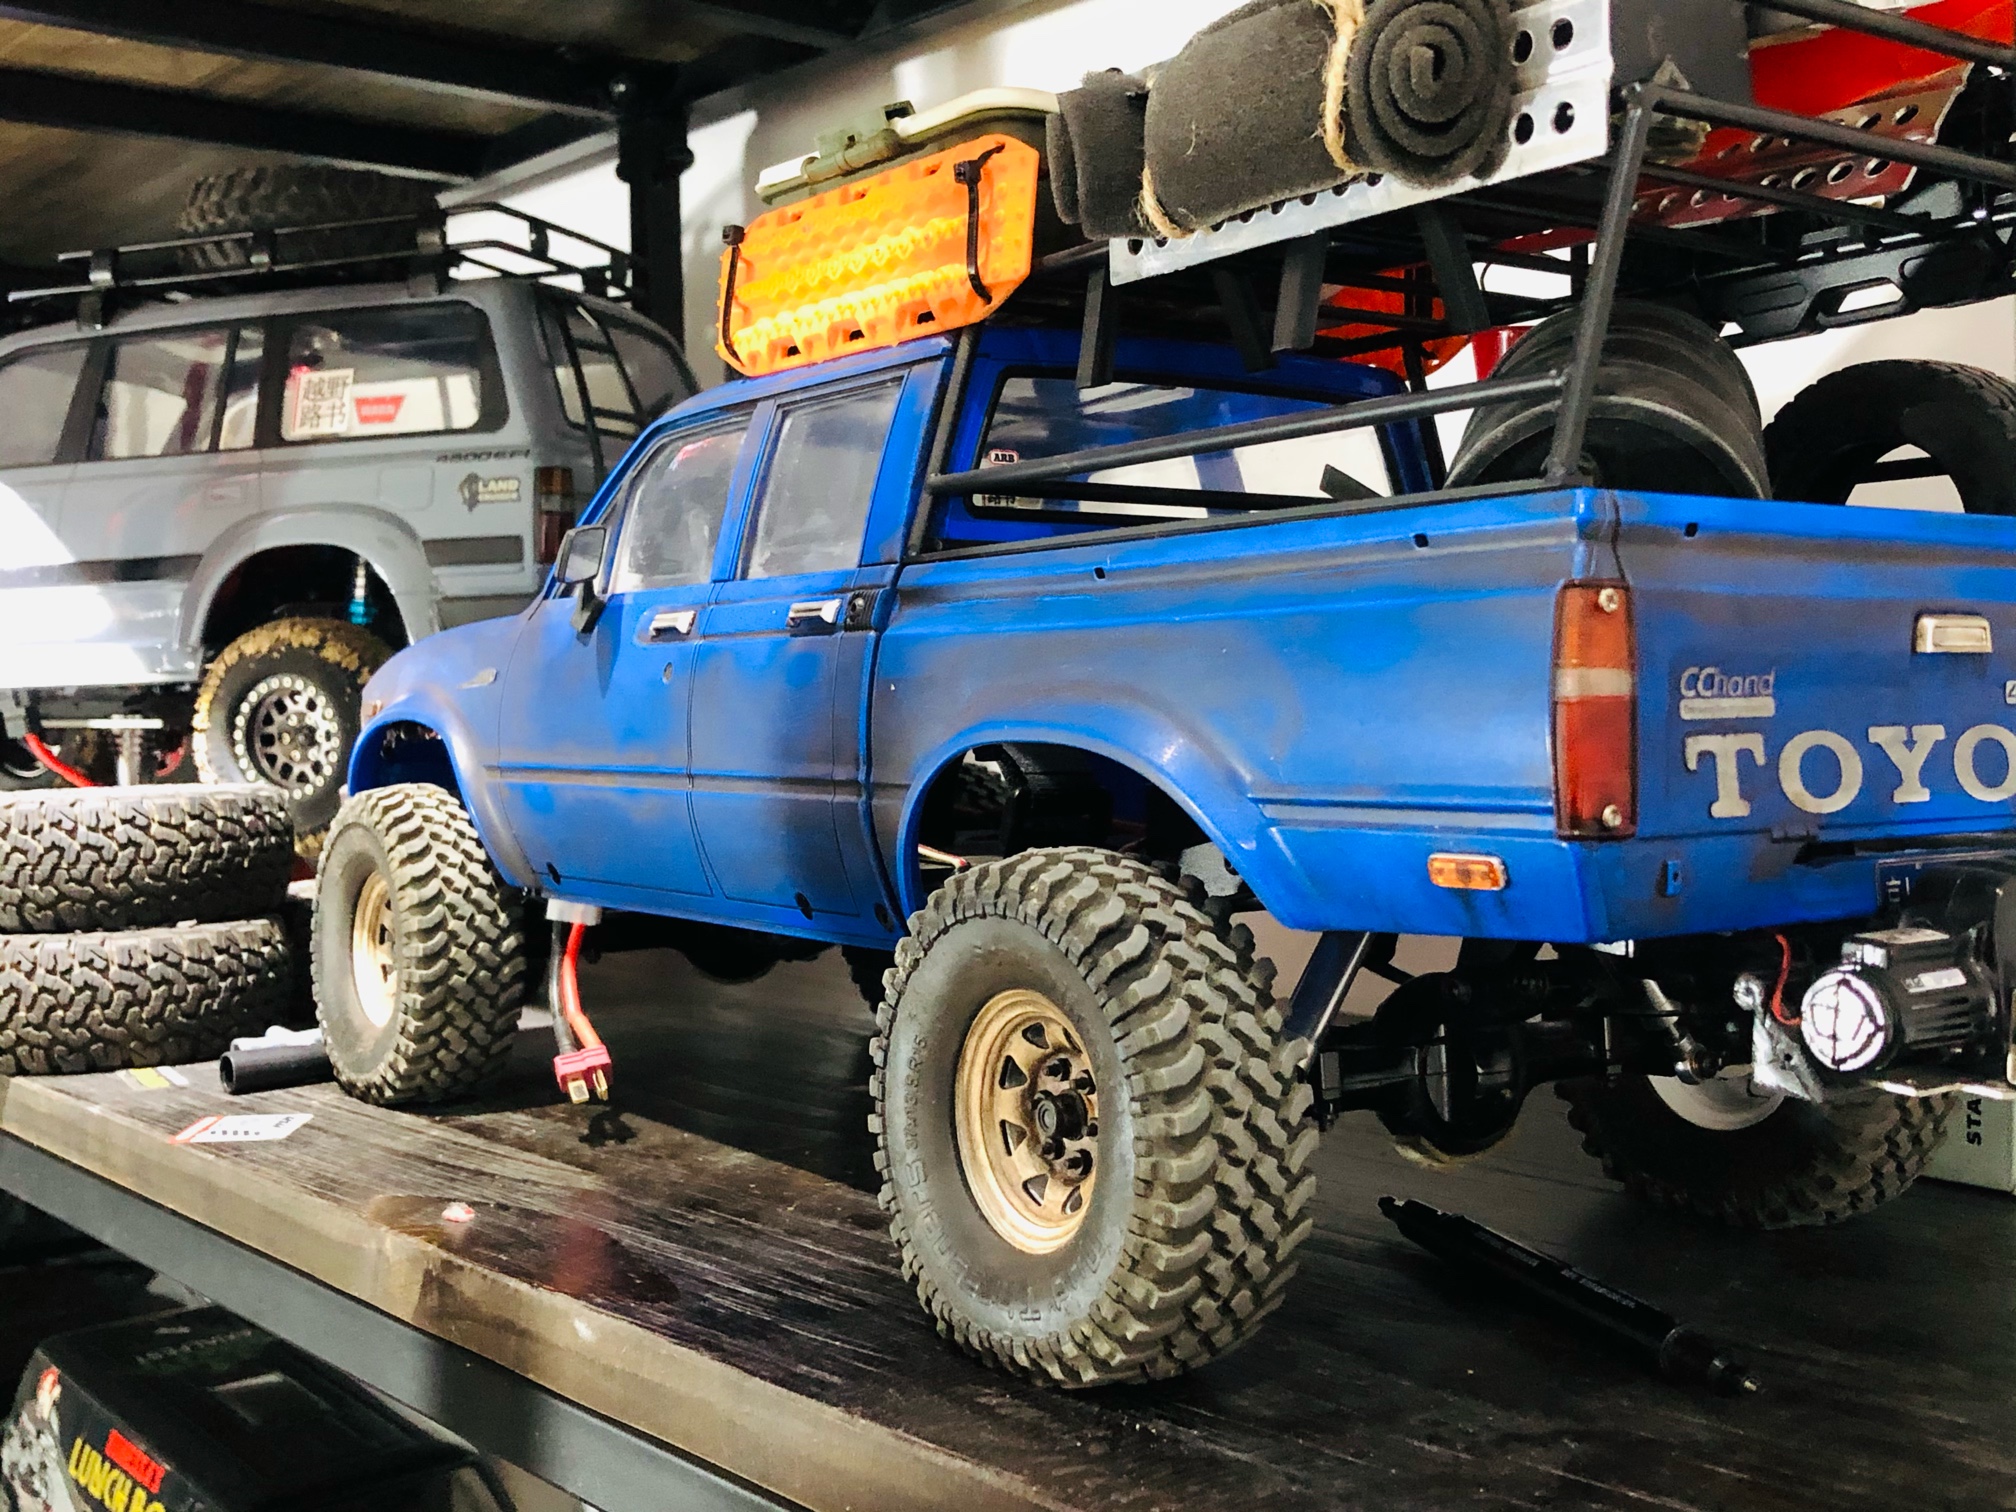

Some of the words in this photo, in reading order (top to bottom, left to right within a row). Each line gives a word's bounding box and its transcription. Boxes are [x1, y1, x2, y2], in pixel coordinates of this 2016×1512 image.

[993, 453, 1016, 463] ARB
[478, 479, 520, 492] LAND
[1685, 723, 2016, 818] TOYO
[1966, 1098, 1982, 1147] STA
[68, 1436, 132, 1512] LUNCH
